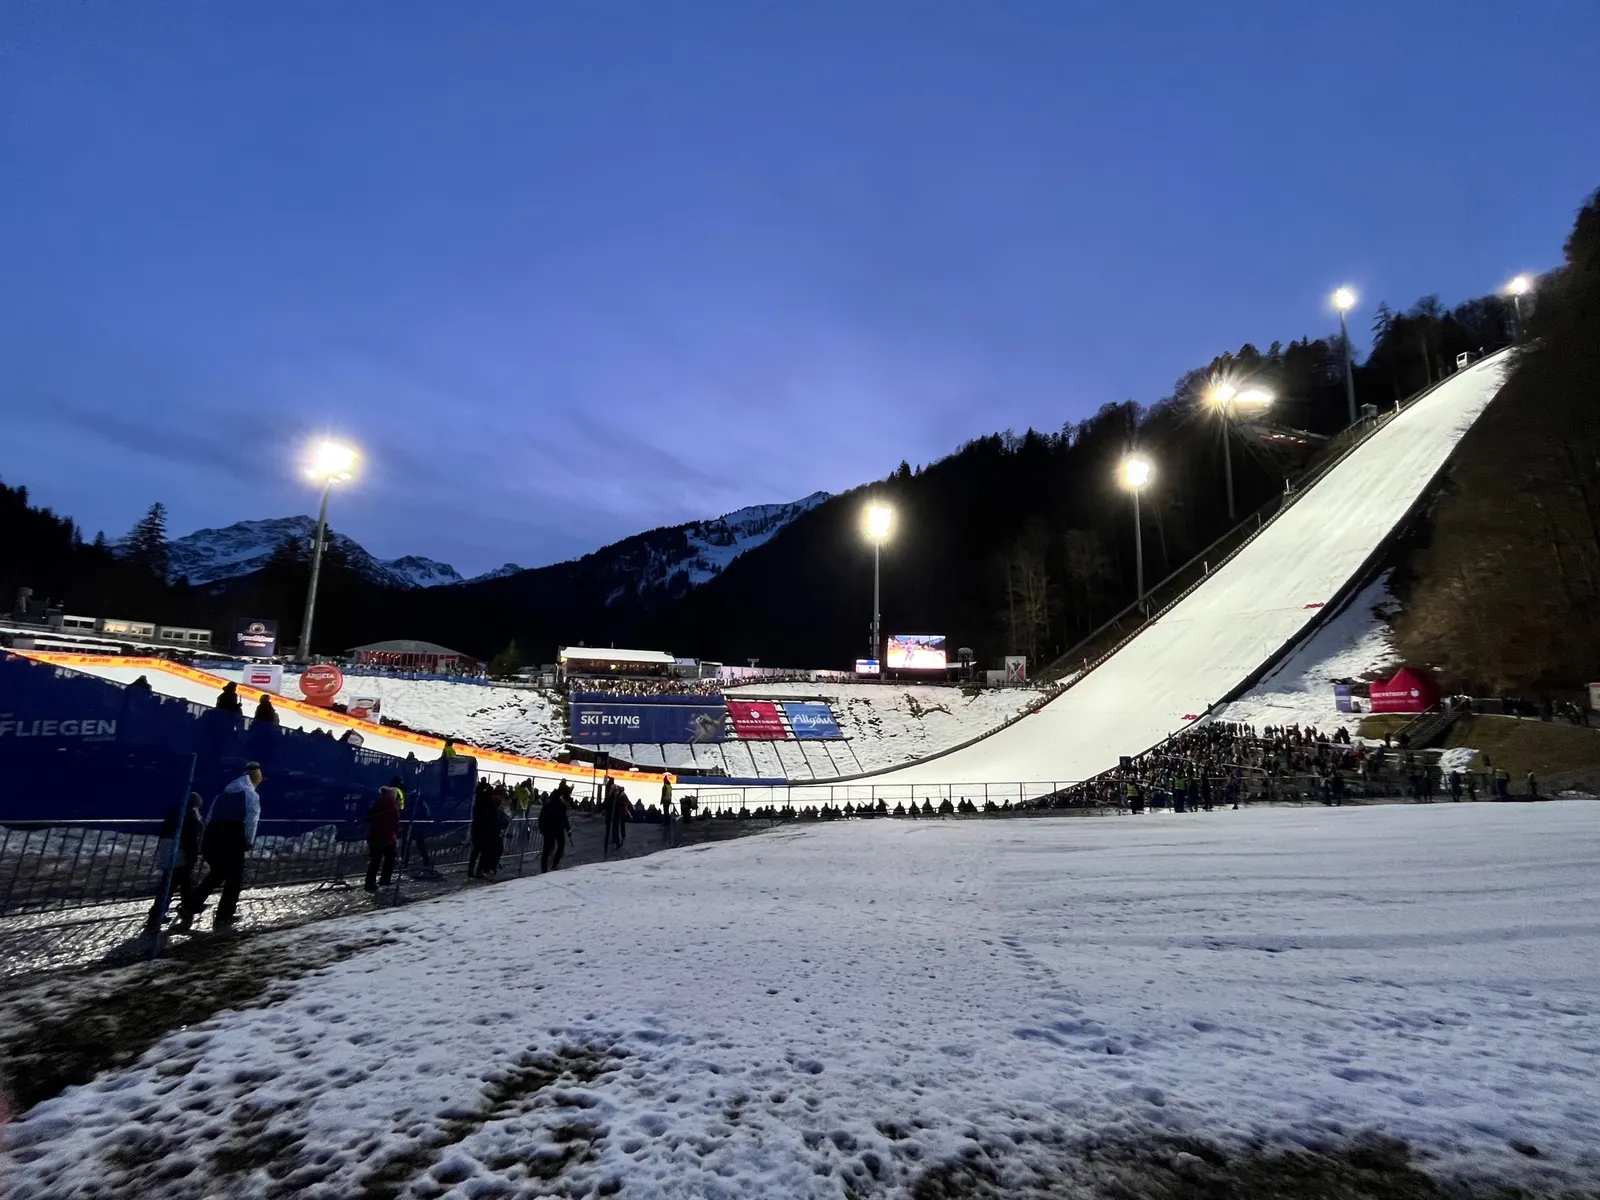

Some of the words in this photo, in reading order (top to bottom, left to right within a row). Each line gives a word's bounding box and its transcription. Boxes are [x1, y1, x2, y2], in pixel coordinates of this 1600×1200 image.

[171, 665, 189, 674] LOTTO
[205, 676, 223, 685] LOTTO
[306, 672, 335, 681] ARGETA
[302, 704, 318, 713] LOTTO
[333, 713, 349, 722] LOTTO
[580, 715, 599, 725] SKI
[601, 715, 640, 725] FLYING
[792, 714, 834, 729] Allgäu
[362, 722, 379, 730] LOTTO
